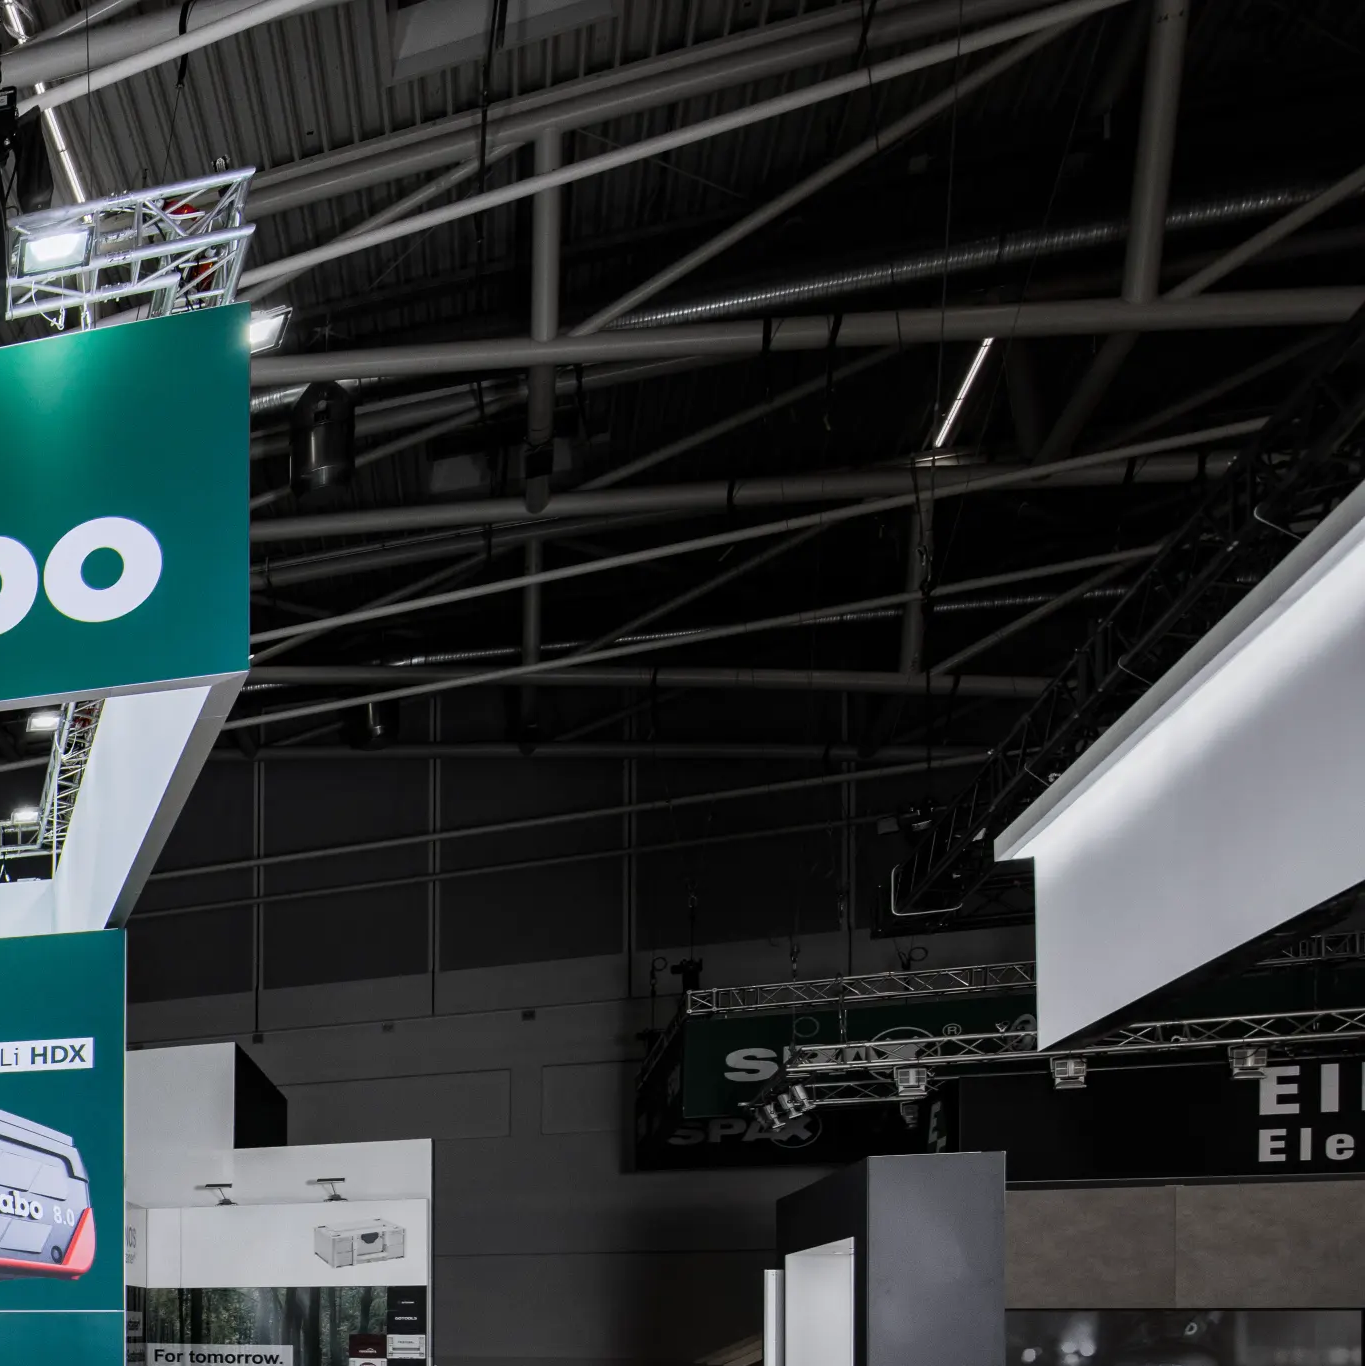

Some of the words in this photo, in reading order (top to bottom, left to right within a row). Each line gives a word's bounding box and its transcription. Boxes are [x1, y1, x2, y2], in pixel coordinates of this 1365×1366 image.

[0, 1048, 19, 1067] Li
[30, 1043, 87, 1065] HDX
[53, 1206, 75, 1228] 8.0
[154, 1349, 184, 1363] For
[189, 1350, 284, 1365] tomorrow.
